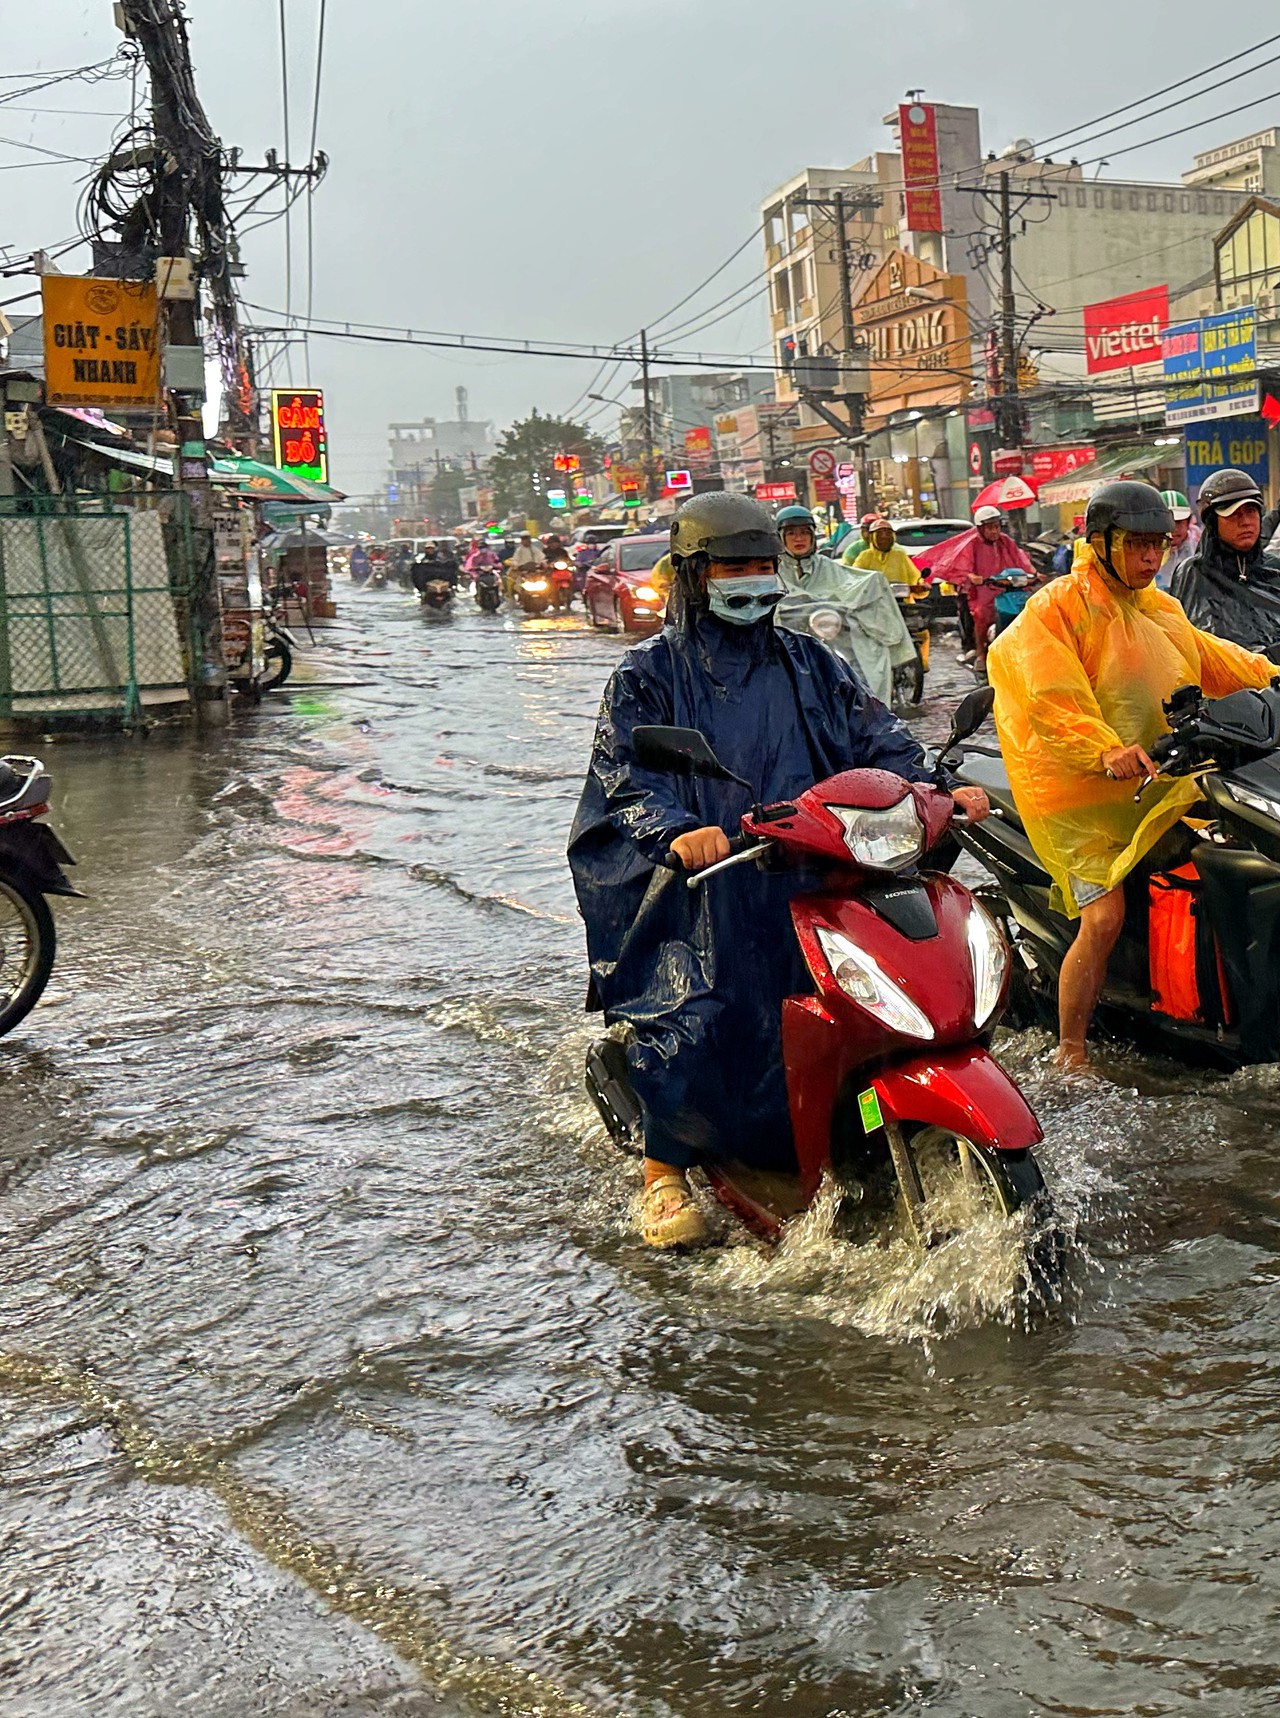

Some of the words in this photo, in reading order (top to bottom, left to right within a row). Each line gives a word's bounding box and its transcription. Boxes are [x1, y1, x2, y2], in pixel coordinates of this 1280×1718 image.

[54, 321, 99, 353] GIẶT
[116, 320, 152, 351] SẤY
[893, 309, 945, 356] LONG
[1088, 316, 1163, 361] viettel
[73, 359, 137, 384] NHANH
[1187, 433, 1223, 465] TRẢ
[1229, 434, 1266, 465] GÓP
[884, 886, 920, 899] HONDA
